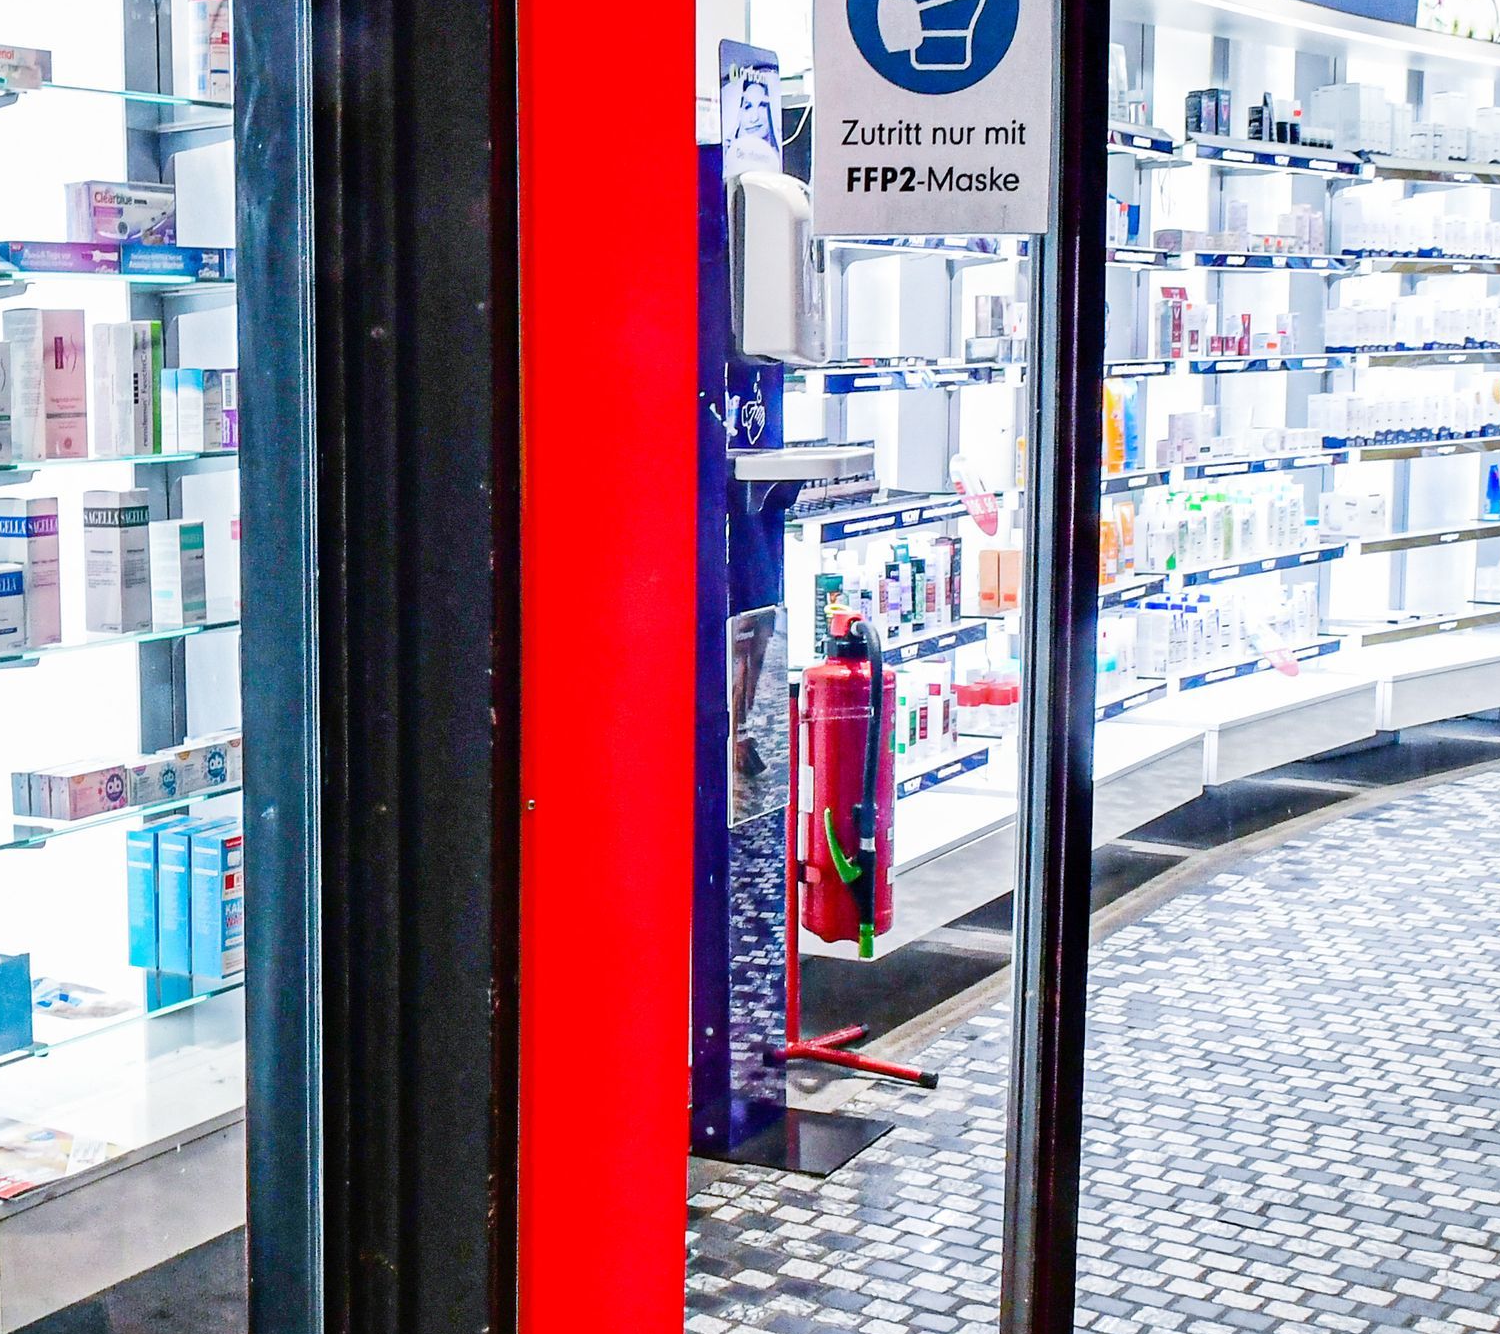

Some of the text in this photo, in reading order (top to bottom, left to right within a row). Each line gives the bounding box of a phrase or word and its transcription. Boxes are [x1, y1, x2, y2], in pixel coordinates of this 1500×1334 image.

[841, 118, 1027, 147] Zutritt nur mit
[845, 165, 1021, 194] FFP2-Maske
[93, 188, 134, 206] Clearblue
[27, 516, 59, 534] SAGELLA
[83, 509, 119, 525] SAGELLA
[119, 508, 150, 524] SAGELLA
